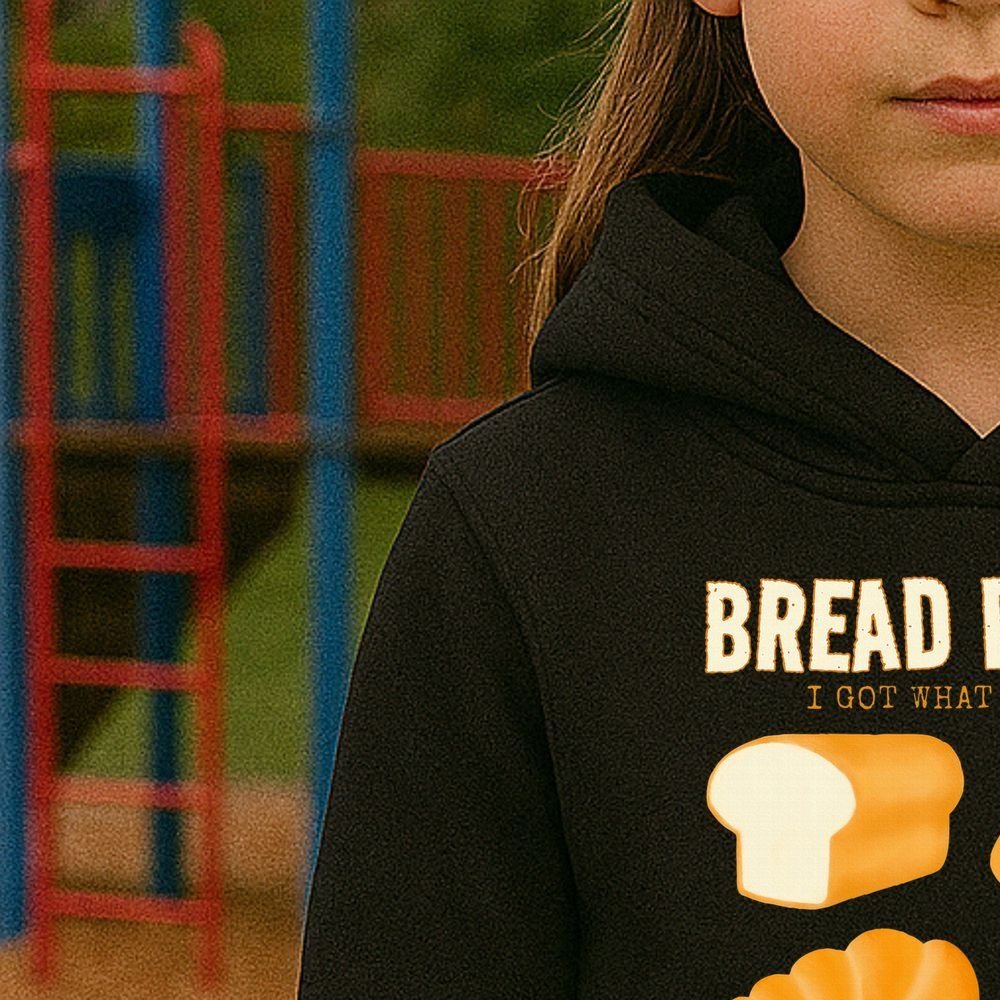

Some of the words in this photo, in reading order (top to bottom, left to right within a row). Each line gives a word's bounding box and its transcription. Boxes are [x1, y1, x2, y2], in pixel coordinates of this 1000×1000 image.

[705, 577, 952, 674] BREAD
[807, 685, 823, 709] I
[837, 685, 897, 709] GOT
[911, 685, 992, 709] WHAT
